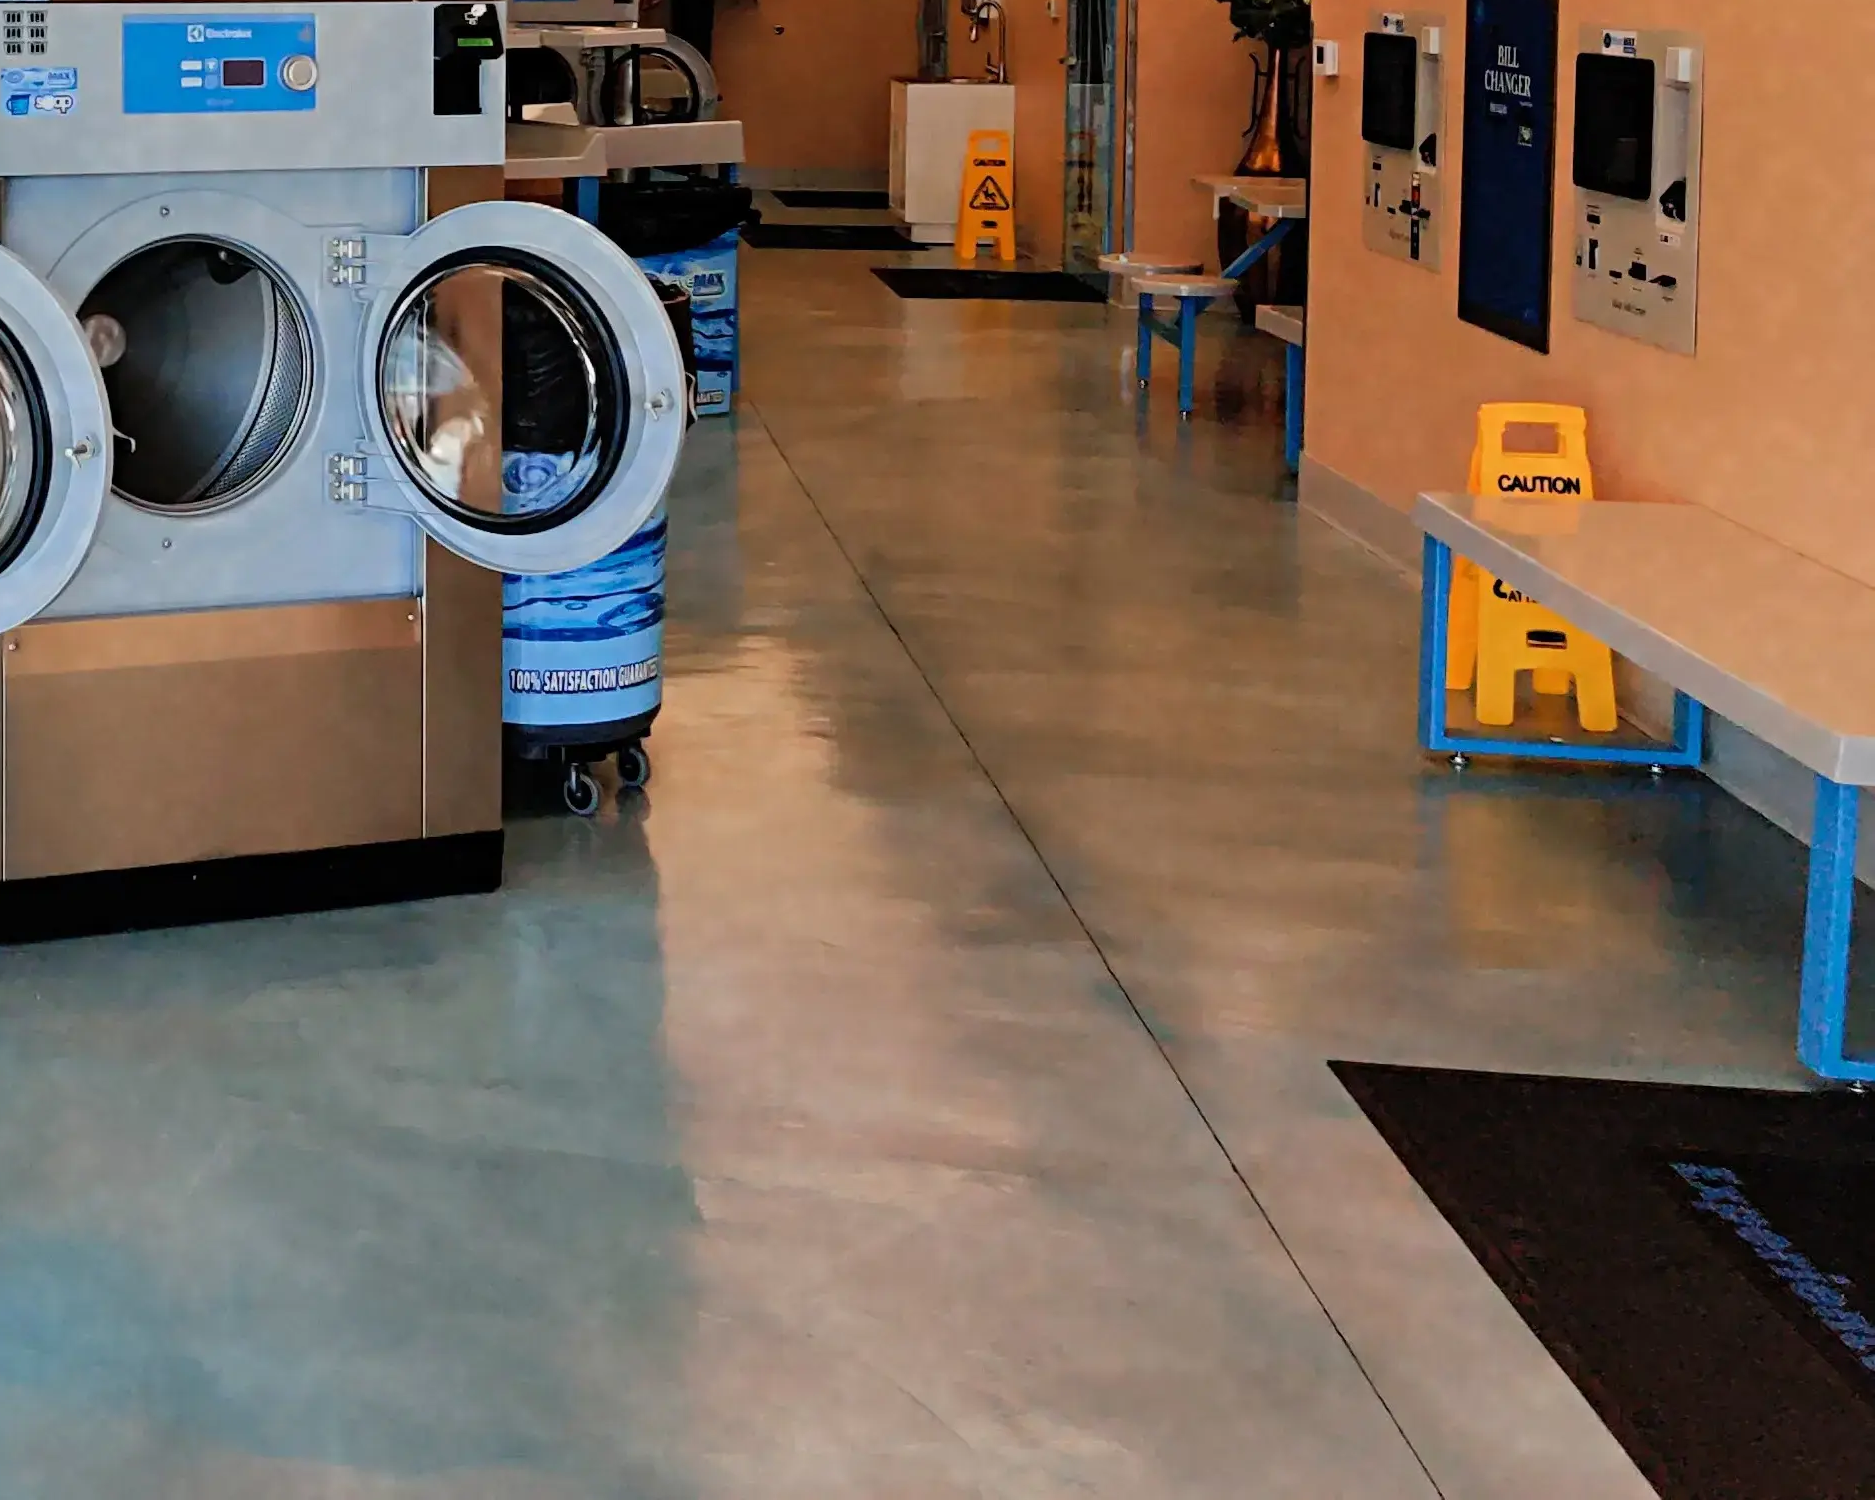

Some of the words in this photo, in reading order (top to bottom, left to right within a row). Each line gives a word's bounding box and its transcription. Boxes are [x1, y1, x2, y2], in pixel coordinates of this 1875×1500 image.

[1497, 44, 1520, 68] BILL
[1484, 69, 1532, 97] CHANGER
[1497, 474, 1581, 495] CAUTION
[510, 669, 542, 693] 100%
[543, 666, 617, 693] SATISFACTION
